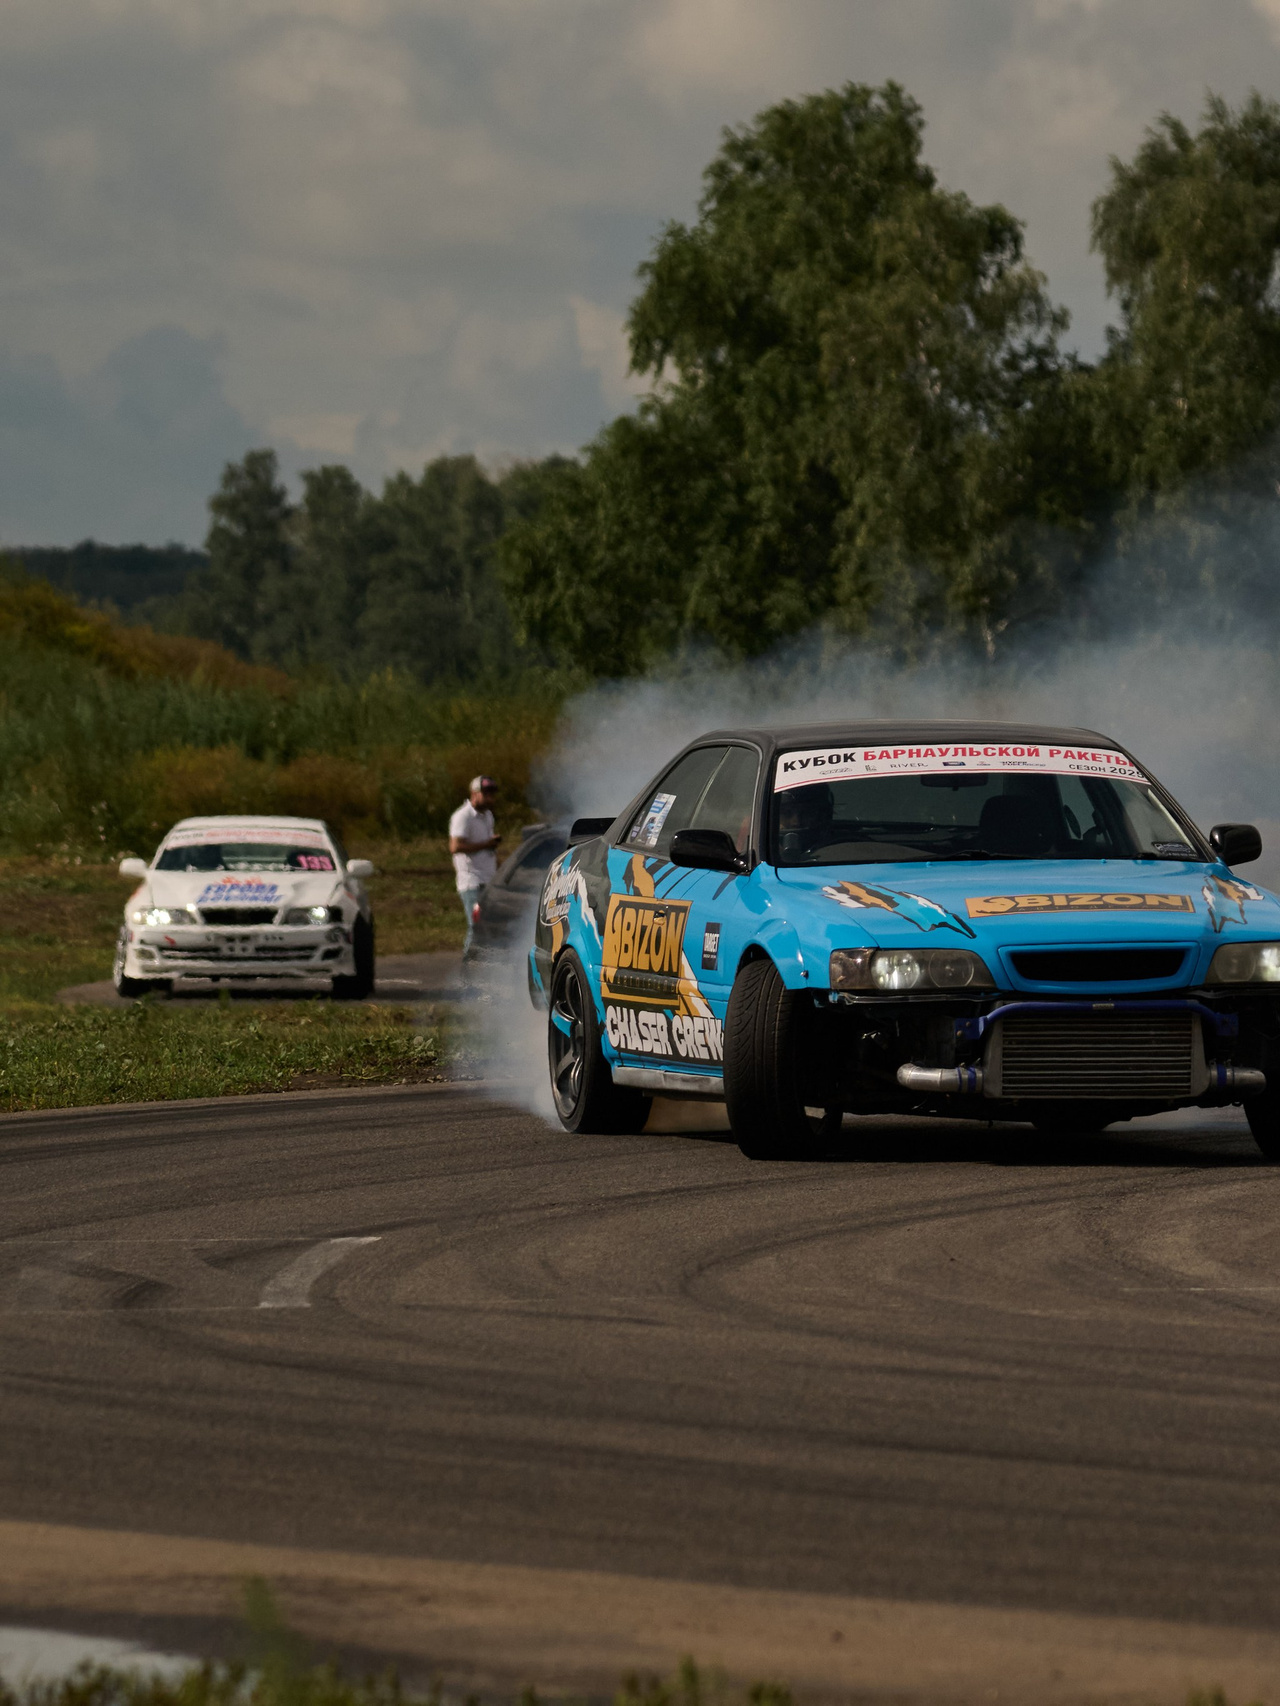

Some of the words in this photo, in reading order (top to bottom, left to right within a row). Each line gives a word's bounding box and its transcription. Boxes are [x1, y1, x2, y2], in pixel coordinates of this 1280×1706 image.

[783, 752, 857, 773] КУБОК
[863, 745, 1040, 761] БАРНАУЛЬСКОЙ
[1068, 763, 1106, 773] СЕЗОН
[1109, 766, 1145, 779] 2025
[1013, 894, 1182, 908] BIZON
[618, 907, 686, 973] BIZON
[606, 1005, 673, 1056] CHASER
[672, 1014, 724, 1061] CREW
